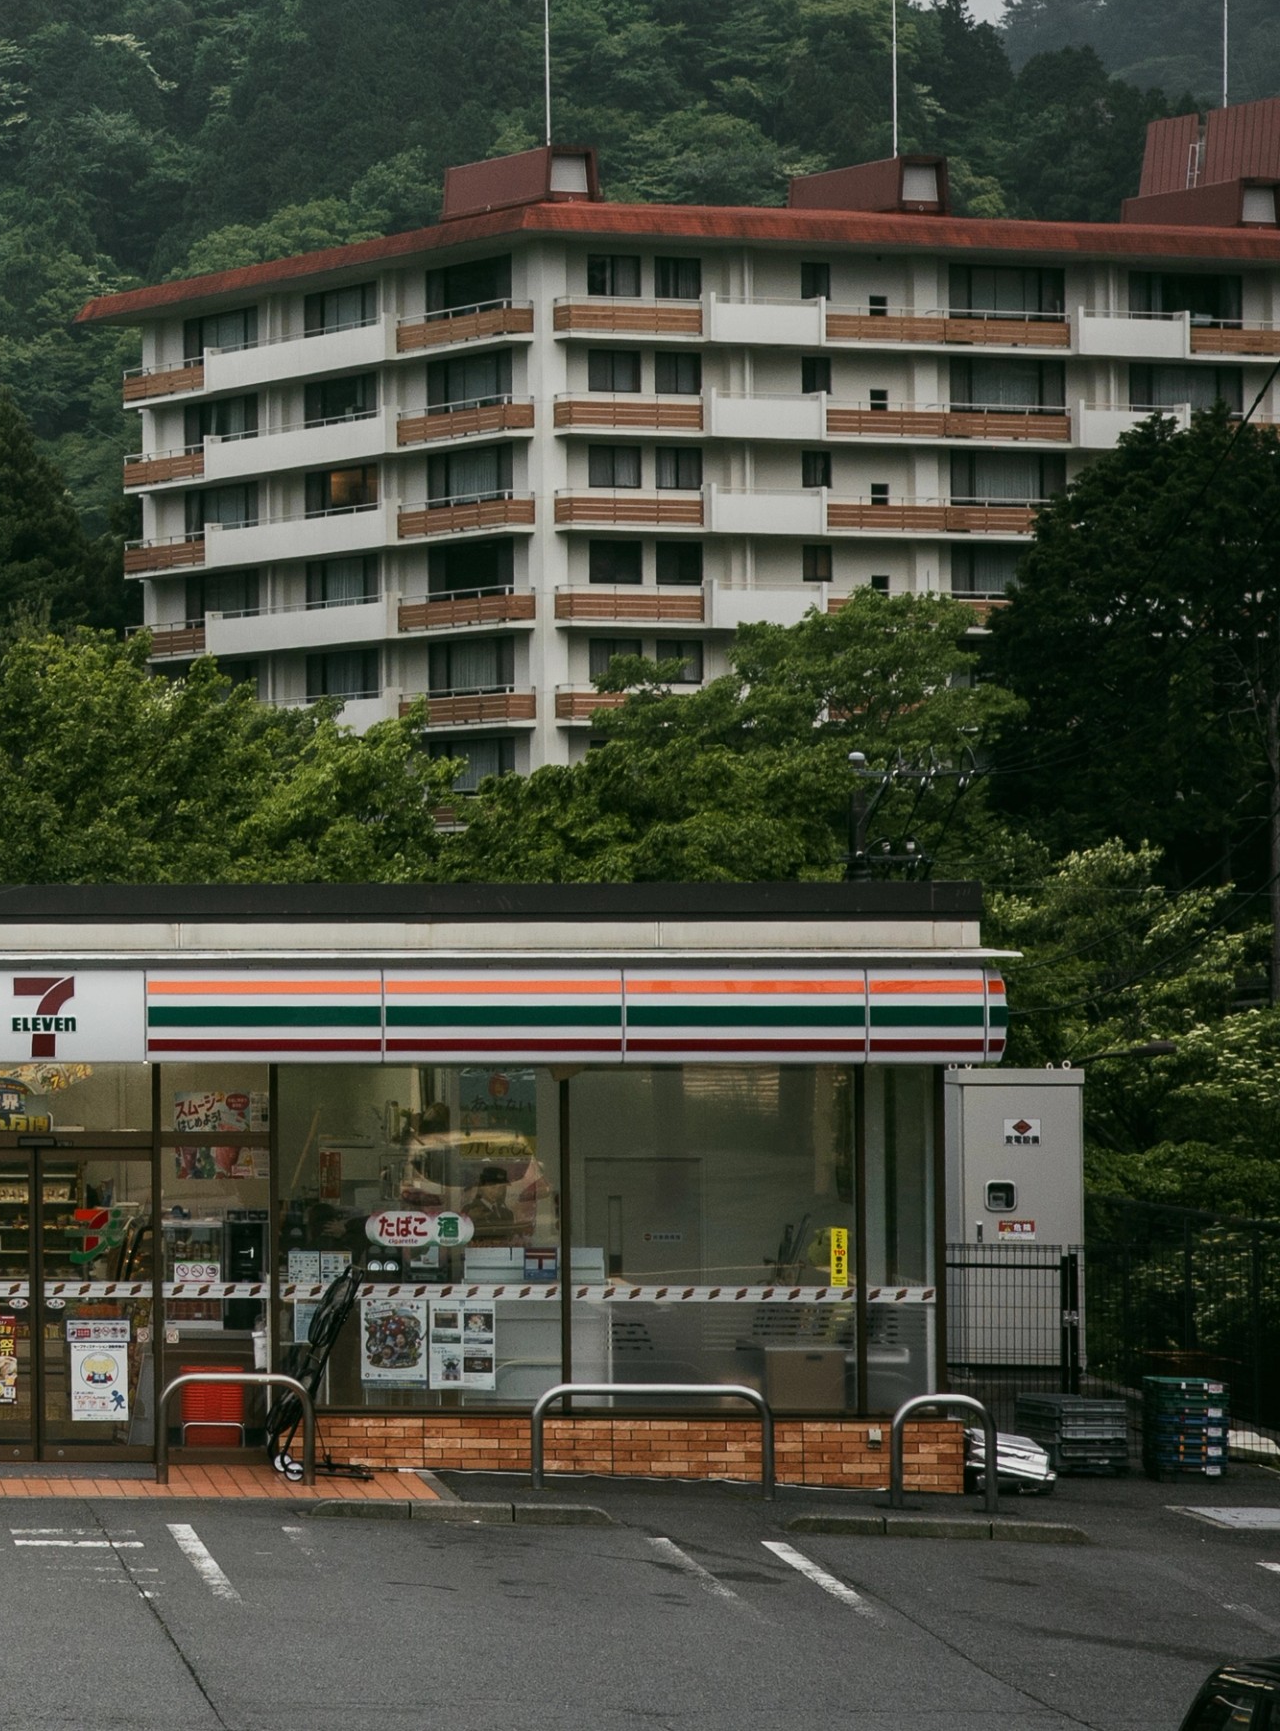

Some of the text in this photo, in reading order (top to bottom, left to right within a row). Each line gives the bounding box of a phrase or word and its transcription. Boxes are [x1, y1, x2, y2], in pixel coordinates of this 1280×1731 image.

[13, 975, 75, 1057] 7
[378, 1217, 459, 1238] たばこ 酒
